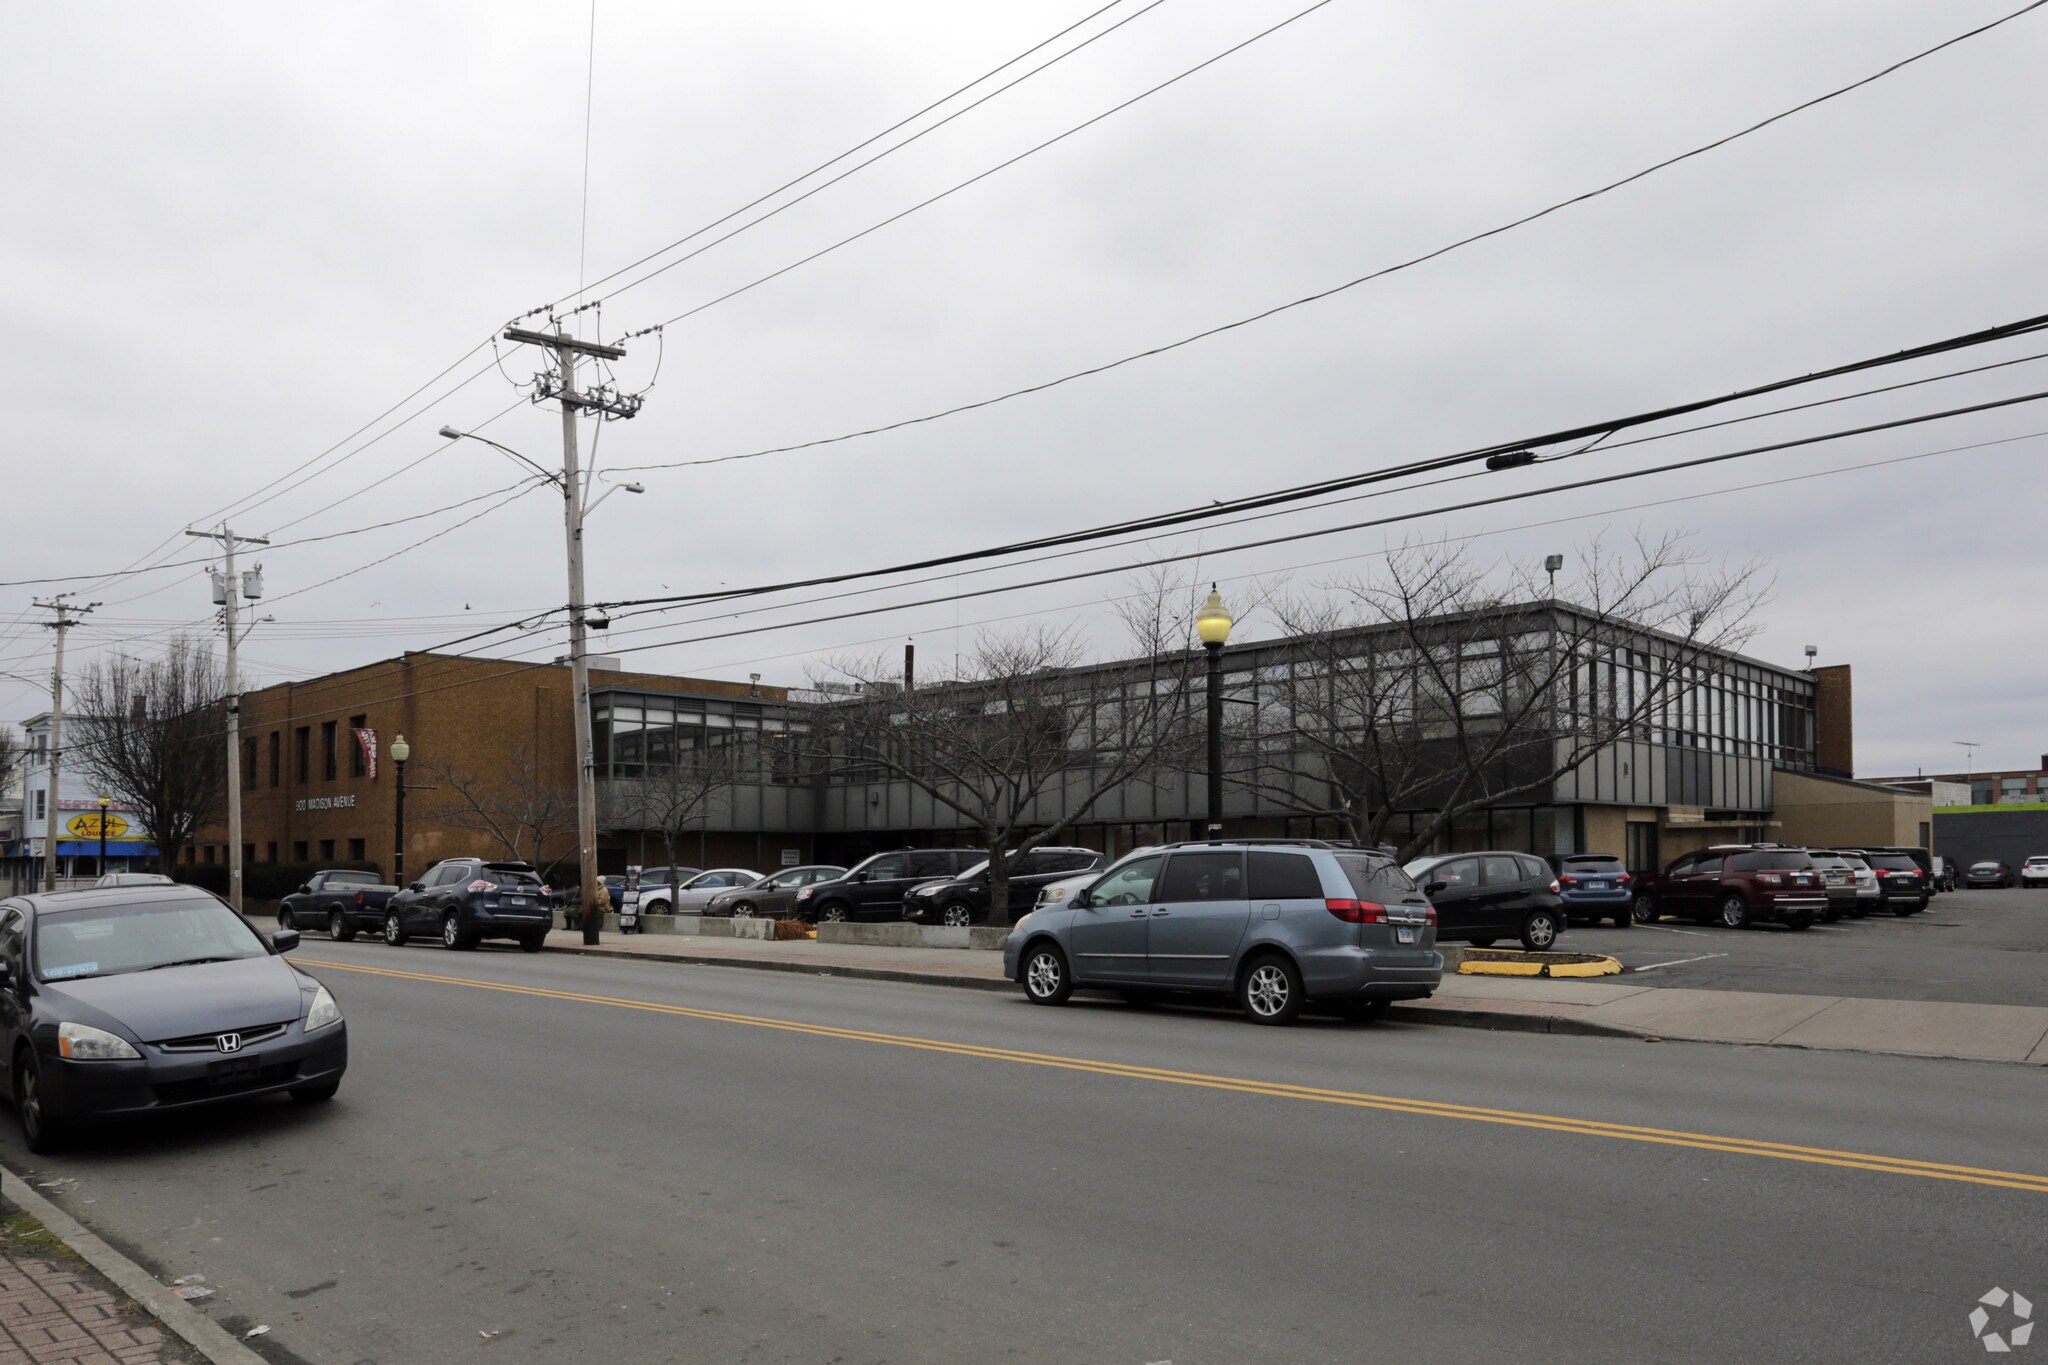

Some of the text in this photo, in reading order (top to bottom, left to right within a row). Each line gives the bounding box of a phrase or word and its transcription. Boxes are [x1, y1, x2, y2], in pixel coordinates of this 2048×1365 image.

[296, 795, 355, 811] 900 MADISON AVENUE
